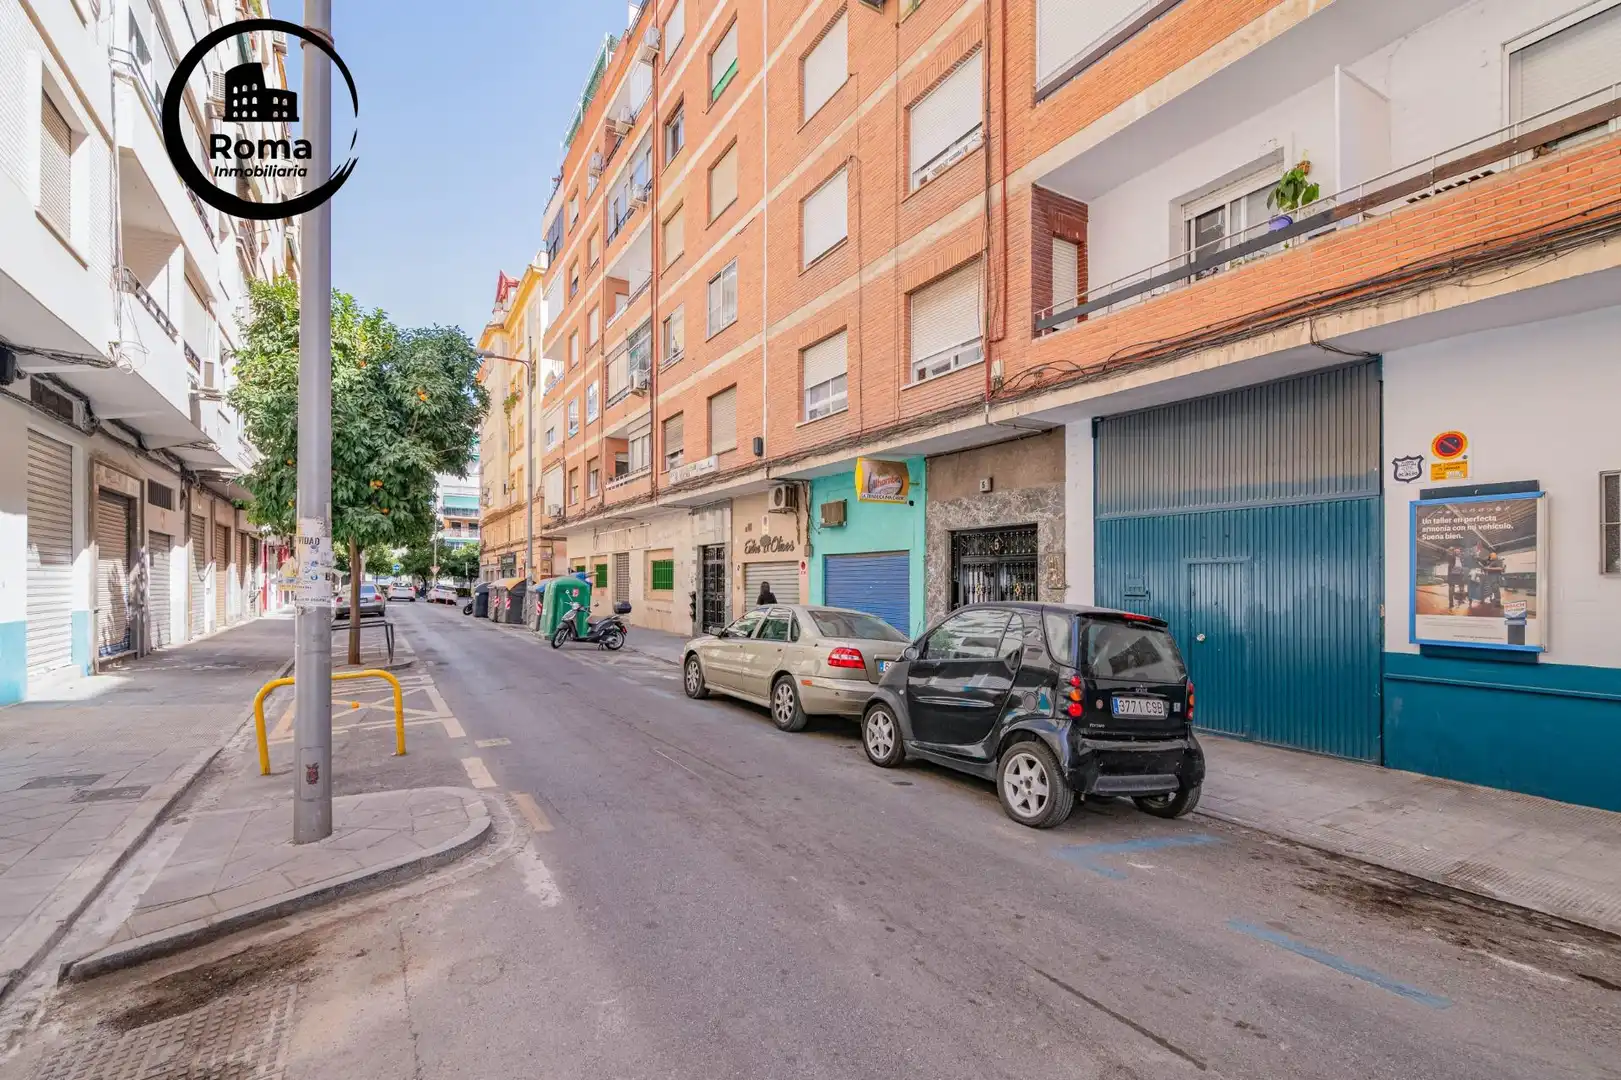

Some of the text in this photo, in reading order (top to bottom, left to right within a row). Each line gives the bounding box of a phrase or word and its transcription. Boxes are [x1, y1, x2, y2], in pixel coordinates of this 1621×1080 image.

[1463, 515, 1497, 524] perfecta
[1422, 533, 1444, 541] Suena
[1119, 700, 1163, 714] 3771 CSB
